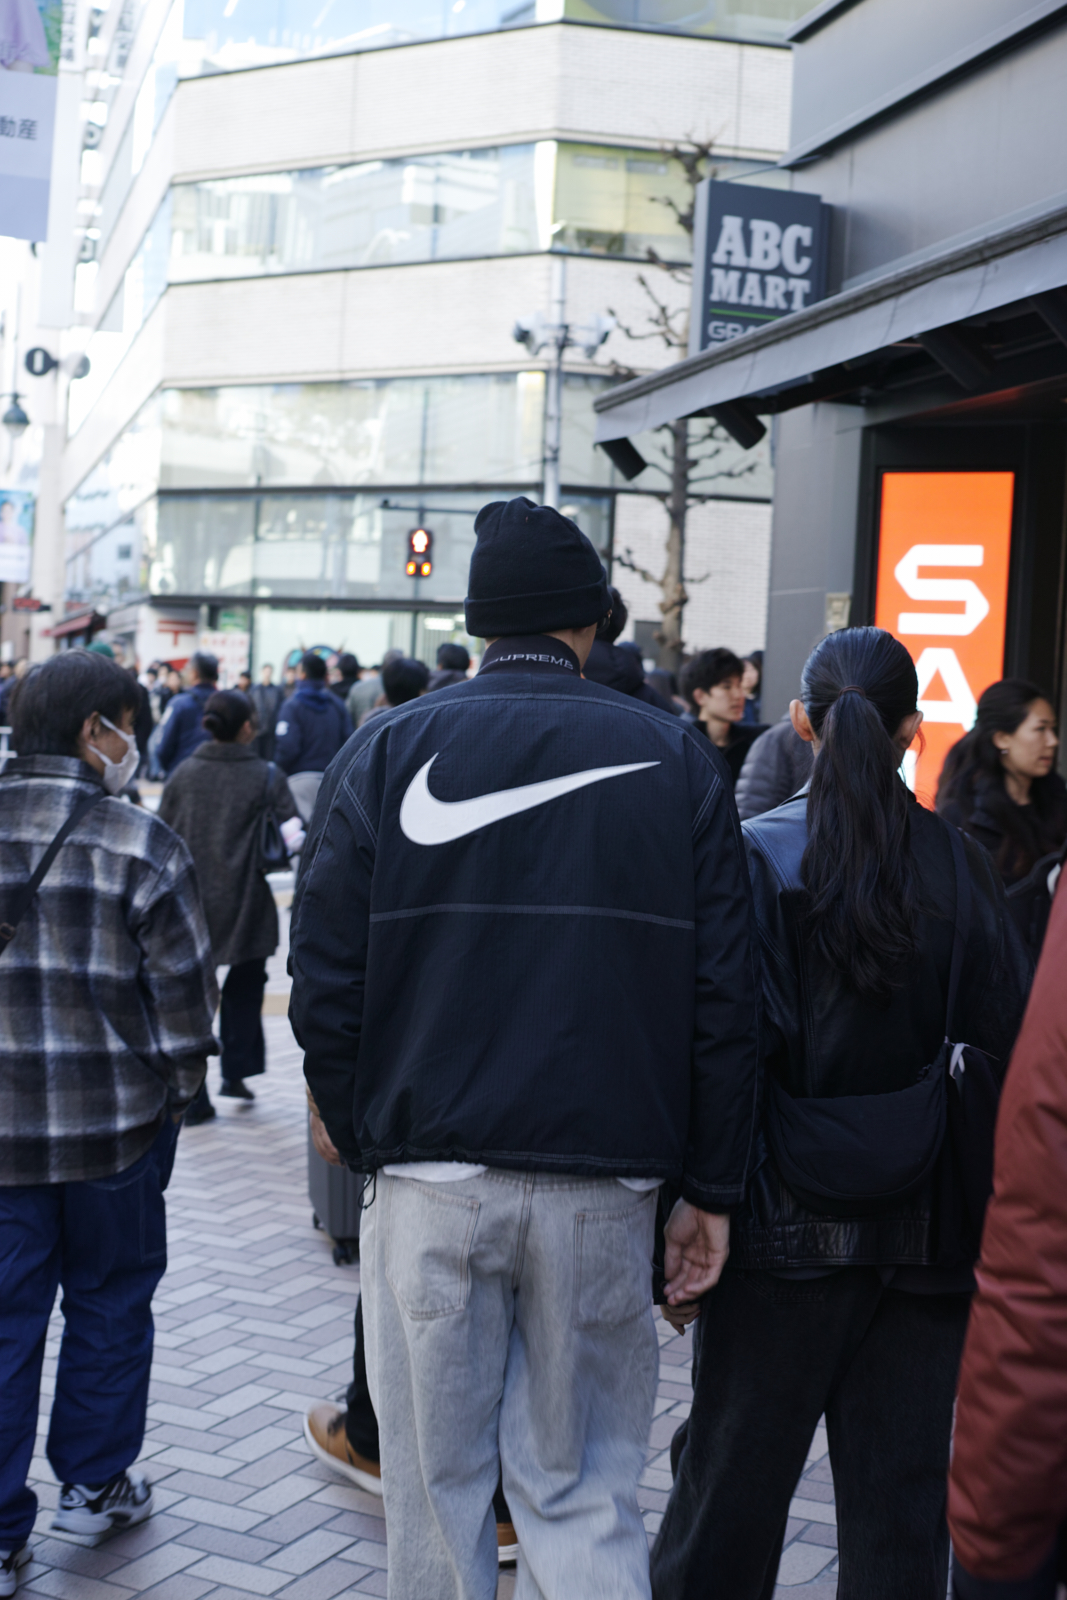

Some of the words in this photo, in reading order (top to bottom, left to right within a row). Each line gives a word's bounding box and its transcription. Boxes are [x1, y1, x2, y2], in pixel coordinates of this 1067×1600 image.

[712, 215, 812, 275] ABC
[709, 268, 811, 311] MART
[496, 653, 574, 670] UPREME
